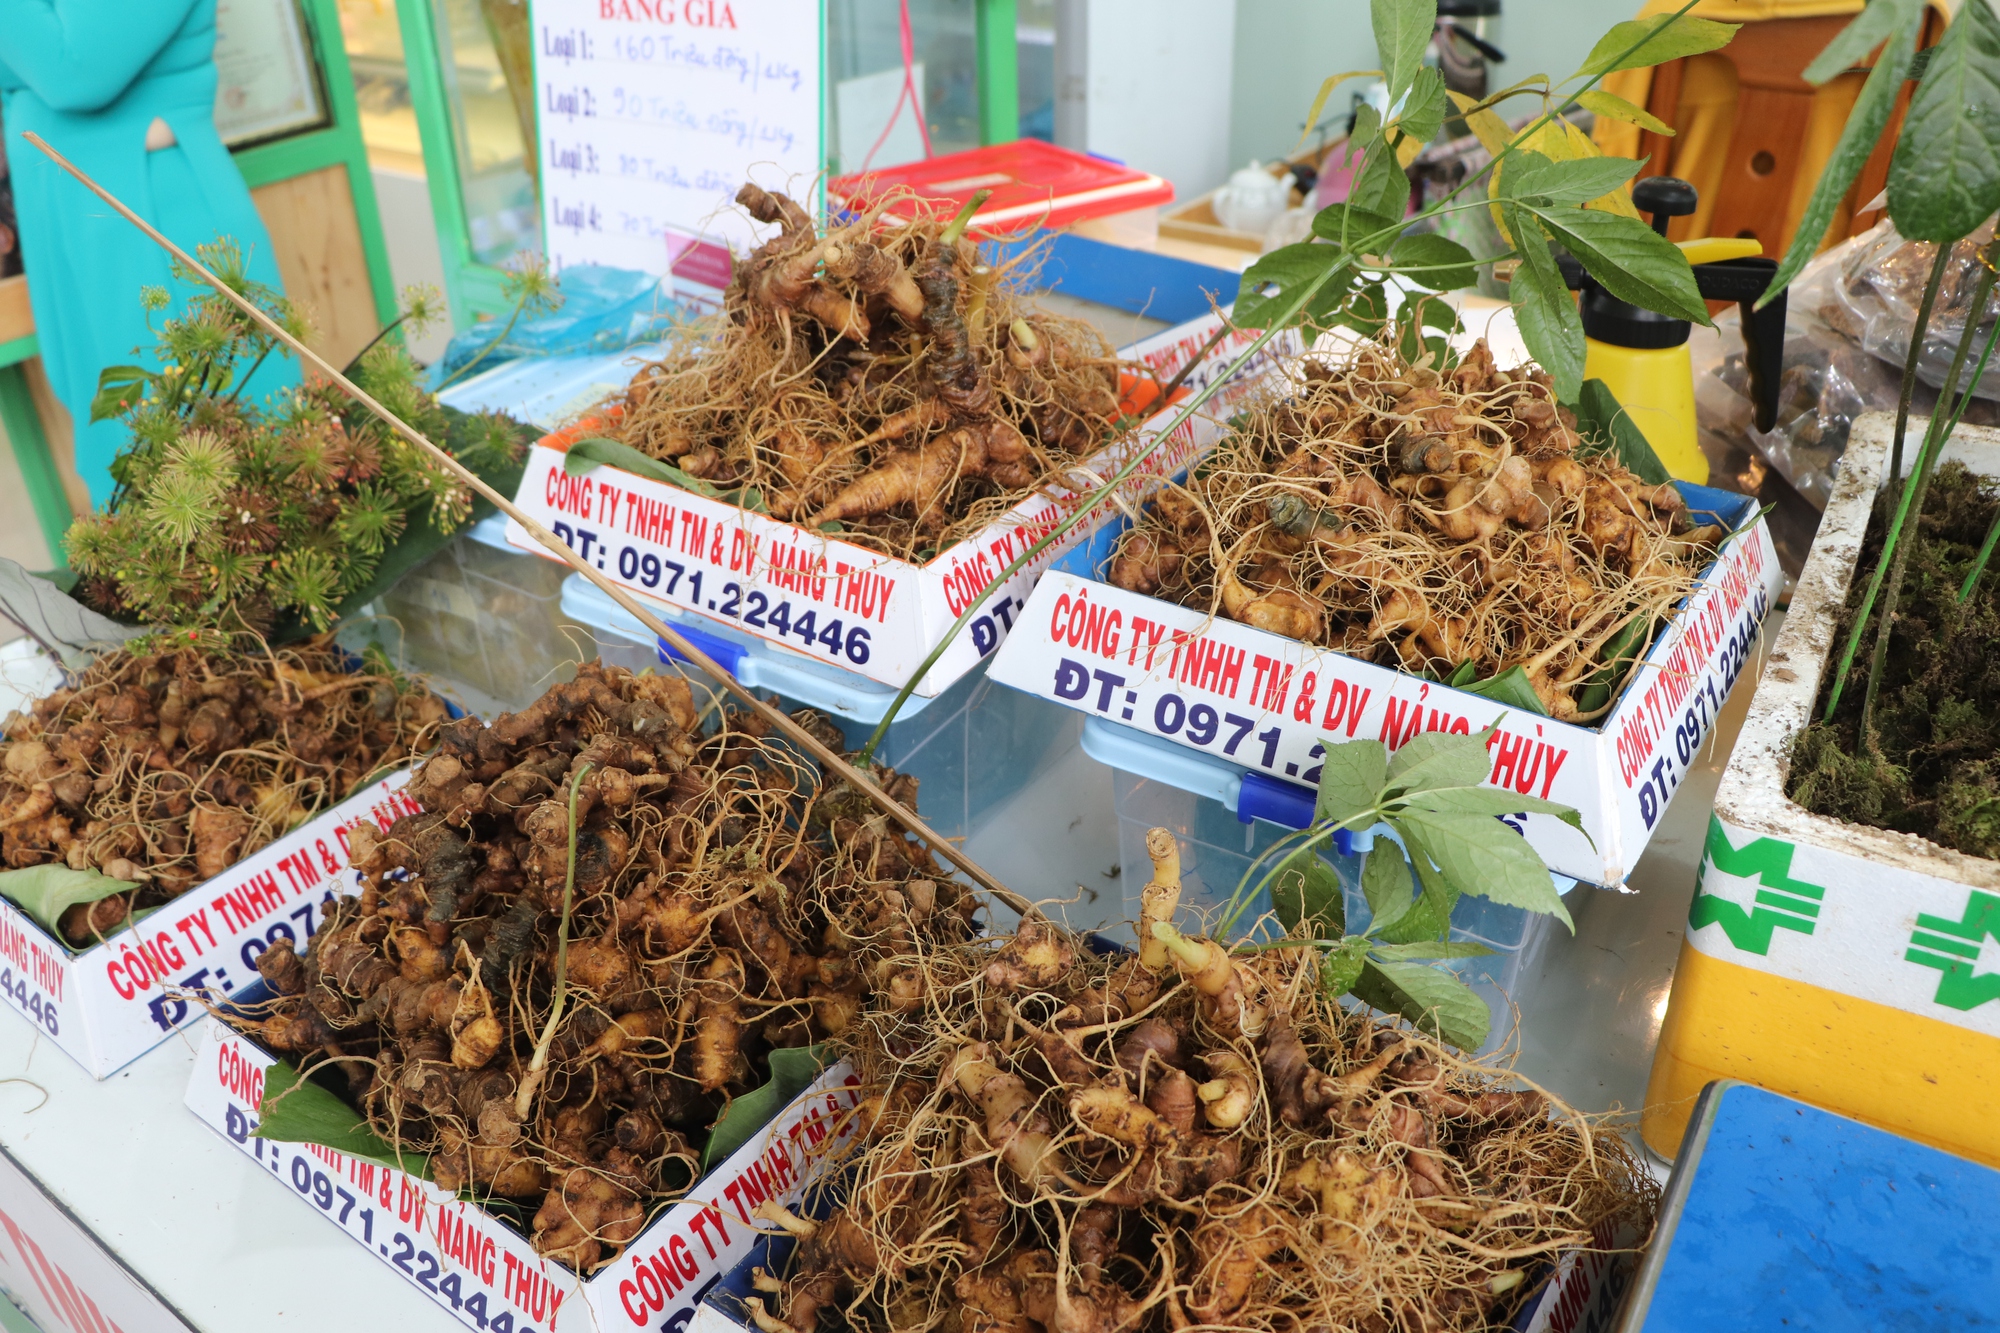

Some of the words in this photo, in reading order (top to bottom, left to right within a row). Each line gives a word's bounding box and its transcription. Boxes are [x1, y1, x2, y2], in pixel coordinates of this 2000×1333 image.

[613, 35, 655, 61] 160
[599, 483, 622, 527] TY
[626, 492, 676, 548] TNHH
[681, 510, 708, 559] TM
[710, 522, 724, 565] &
[730, 526, 761, 576] DV
[834, 558, 896, 623] THÙY
[943, 556, 998, 618] CÔNG
[619, 545, 872, 665] 0971.224446
[1700, 612, 1715, 657] &
[1707, 589, 1724, 645] DV
[1658, 642, 1690, 718] TNHH
[1684, 620, 1706, 678] TM
[1051, 588, 1122, 659] CÔNG
[1131, 615, 1166, 672] TY
[1171, 628, 1246, 700] TNHH
[1249, 653, 1293, 715] TM
[1294, 671, 1316, 724] &
[1322, 678, 1372, 737] DV
[1482, 724, 1569, 800] THÙY
[1053, 658, 1139, 721] ĐT:
[1644, 681, 1666, 741] TY
[1617, 715, 1653, 788] CÔNG
[1638, 755, 1677, 832] ĐT:
[107, 931, 187, 1001] CÔNG
[175, 908, 218, 957] TY
[211, 869, 286, 935] TNHH
[277, 848, 322, 895] TM
[315, 838, 342, 875] &
[31, 940, 64, 1003] THÙY
[219, 1041, 263, 1111] CÔNG
[399, 1176, 427, 1233] DV
[437, 1202, 496, 1288] NẢNG
[503, 1250, 565, 1333] THÙY
[291, 1155, 538, 1333] 0971.22444
[618, 1234, 700, 1327] CÔNG
[688, 1198, 732, 1261] TY
[723, 1139, 798, 1225] TNHH
